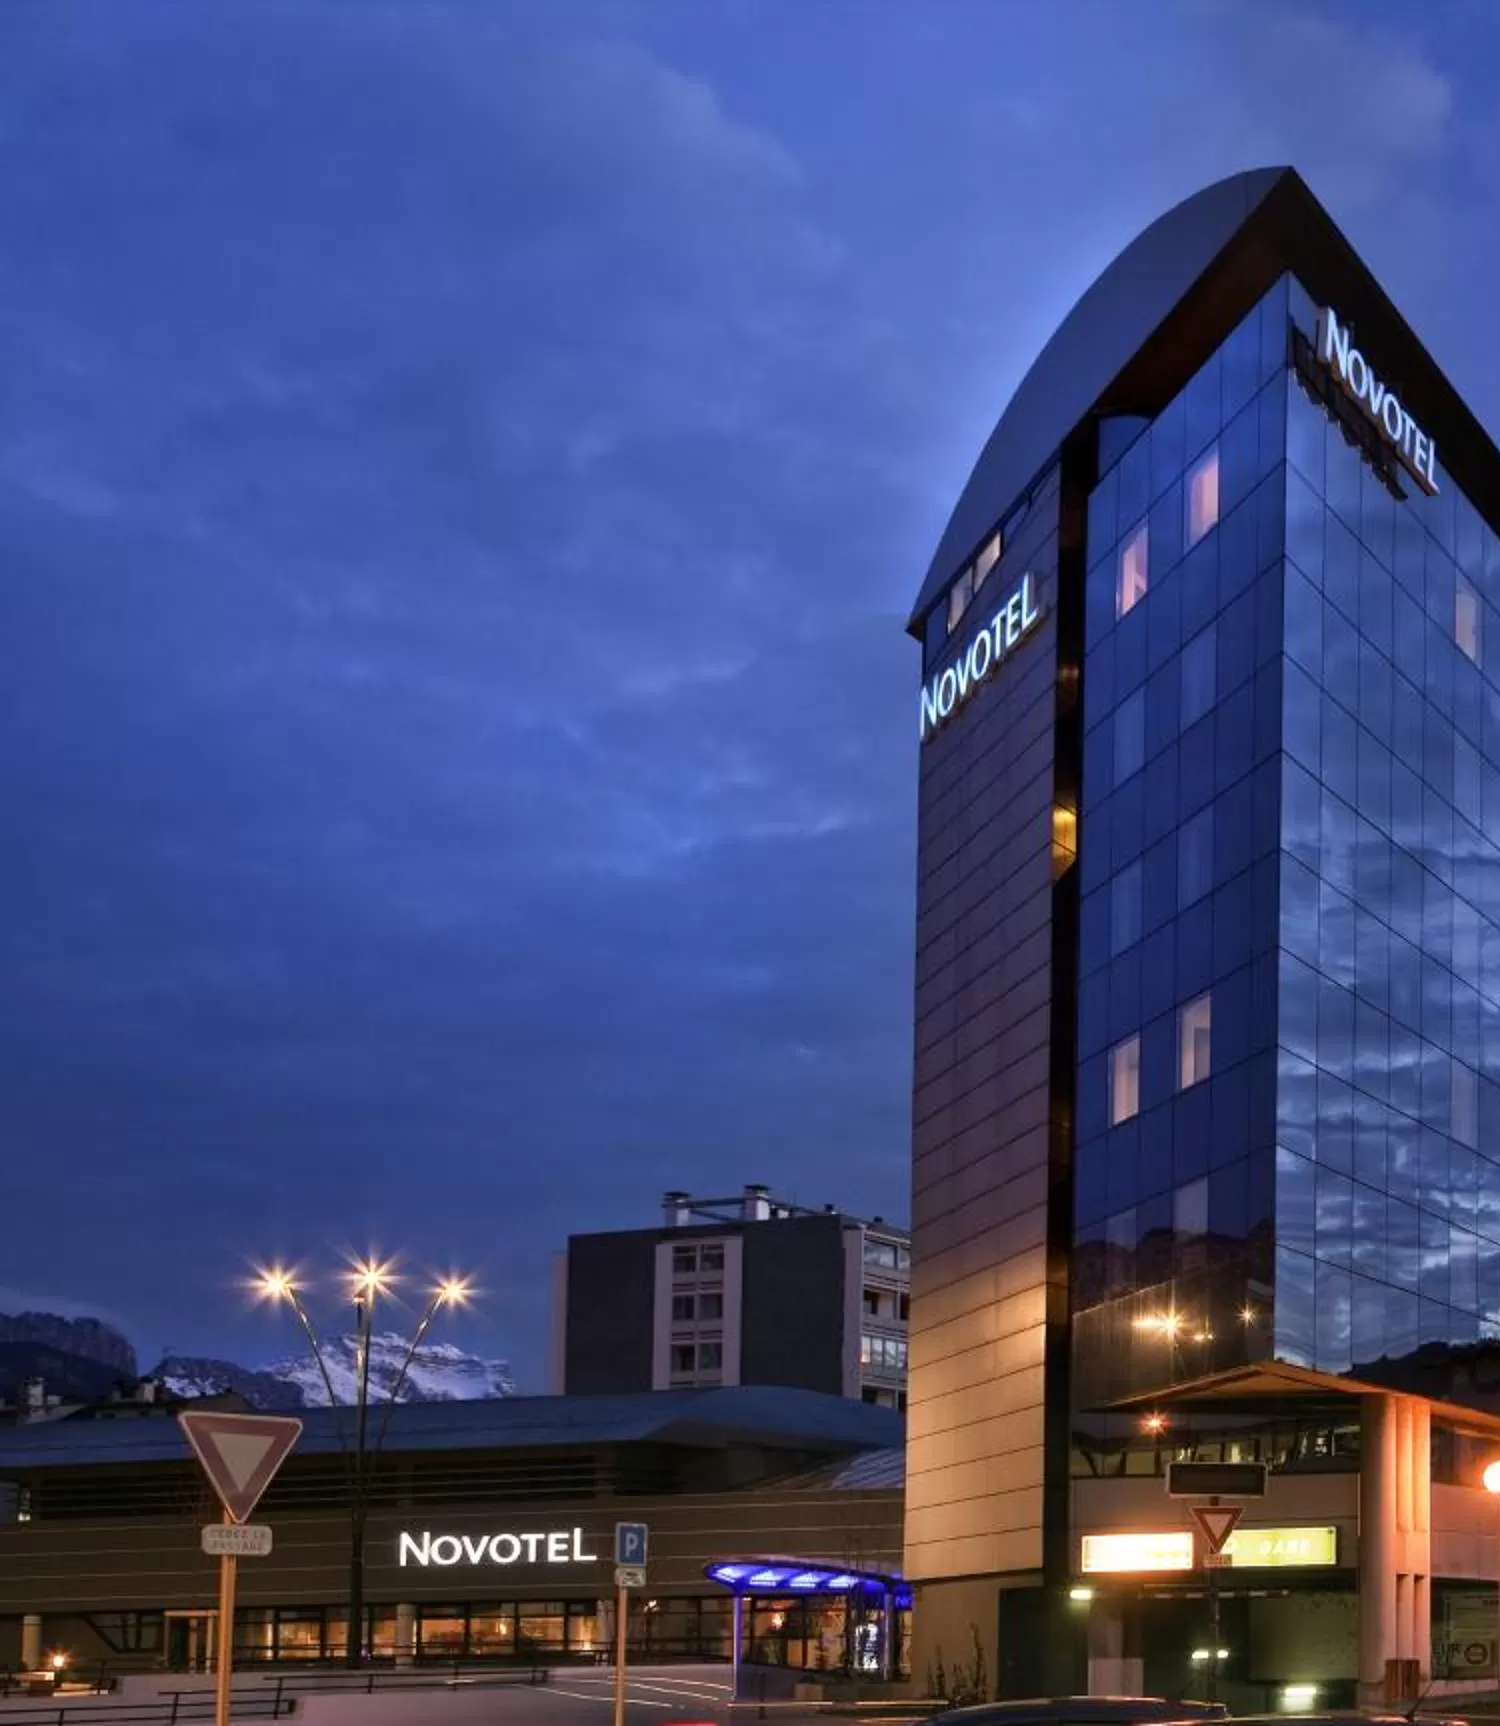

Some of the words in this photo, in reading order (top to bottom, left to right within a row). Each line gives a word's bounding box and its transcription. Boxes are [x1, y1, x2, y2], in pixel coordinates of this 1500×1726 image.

[1325, 306, 1440, 494] NOVOTEL
[920, 572, 1038, 739] NOVOTEL
[400, 1527, 598, 1567] NOVOTEL
[625, 1531, 639, 1558] P
